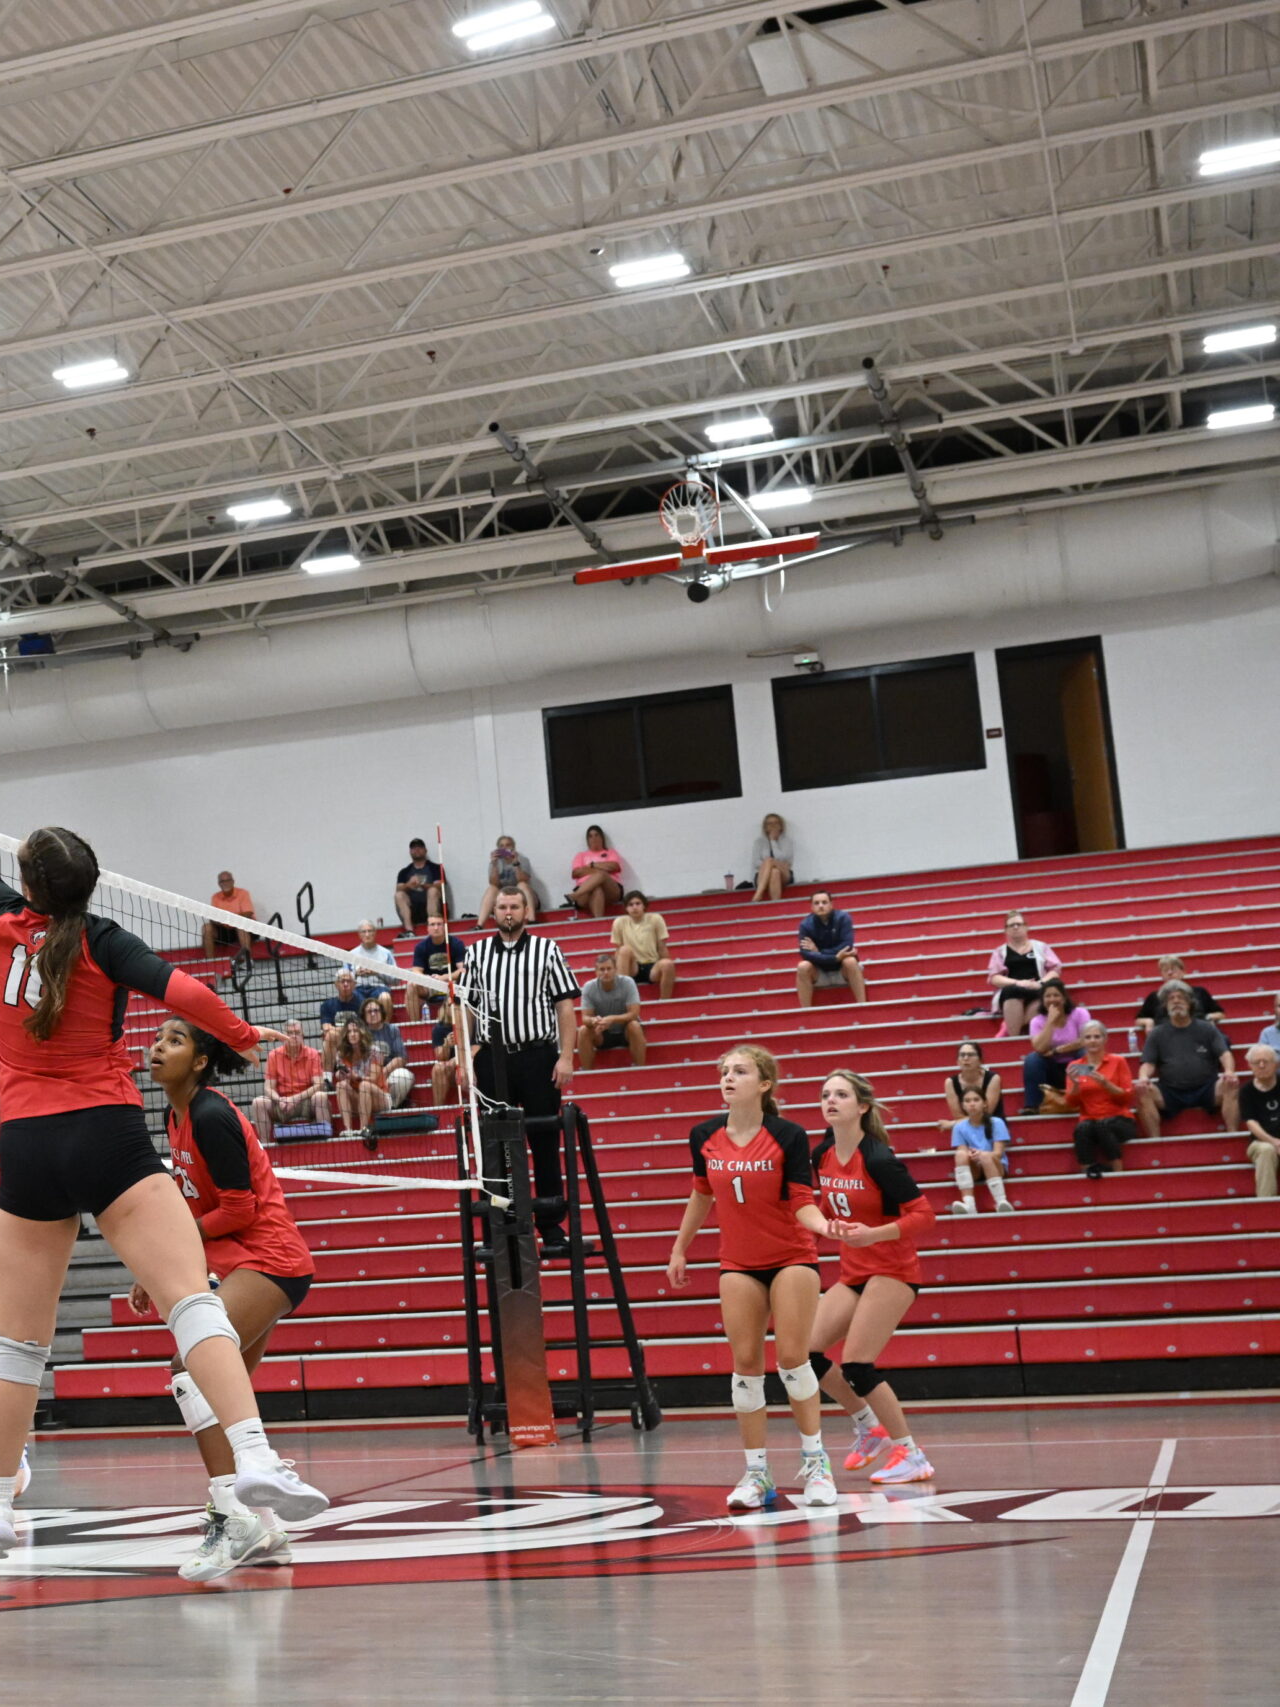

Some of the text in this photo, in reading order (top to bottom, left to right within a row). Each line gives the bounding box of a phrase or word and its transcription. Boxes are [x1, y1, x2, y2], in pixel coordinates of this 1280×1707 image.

[727, 1159, 774, 1171] CHAPEL
[731, 1176, 745, 1204] 1
[819, 1175, 865, 1190] OX CHAPEL
[827, 1191, 852, 1217] 19
